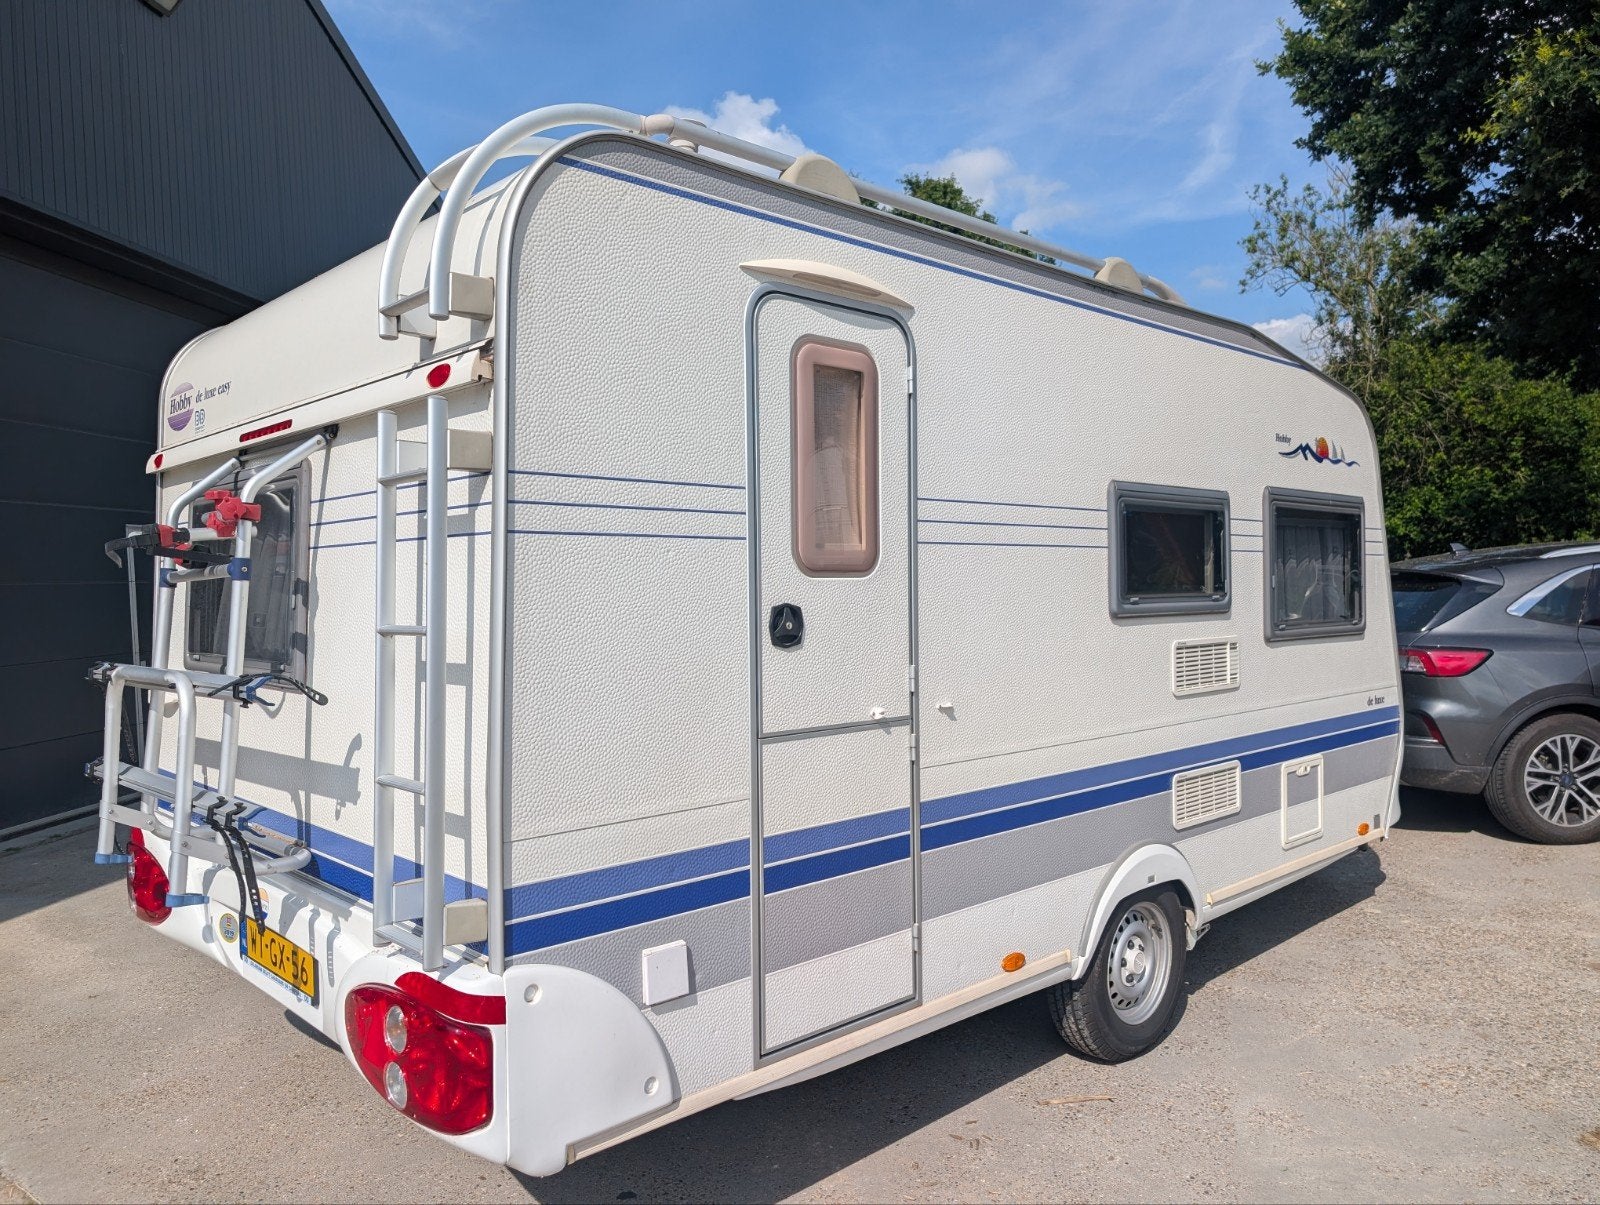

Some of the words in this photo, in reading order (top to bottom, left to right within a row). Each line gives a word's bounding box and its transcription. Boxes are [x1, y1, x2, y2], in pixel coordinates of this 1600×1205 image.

[170, 392, 193, 415] Hobby
[196, 390, 204, 403] de
[204, 387, 217, 400] luxe
[218, 381, 232, 396] easy
[1275, 433, 1291, 446] Hobby
[1367, 696, 1374, 706] de
[1375, 695, 1385, 705] luxe
